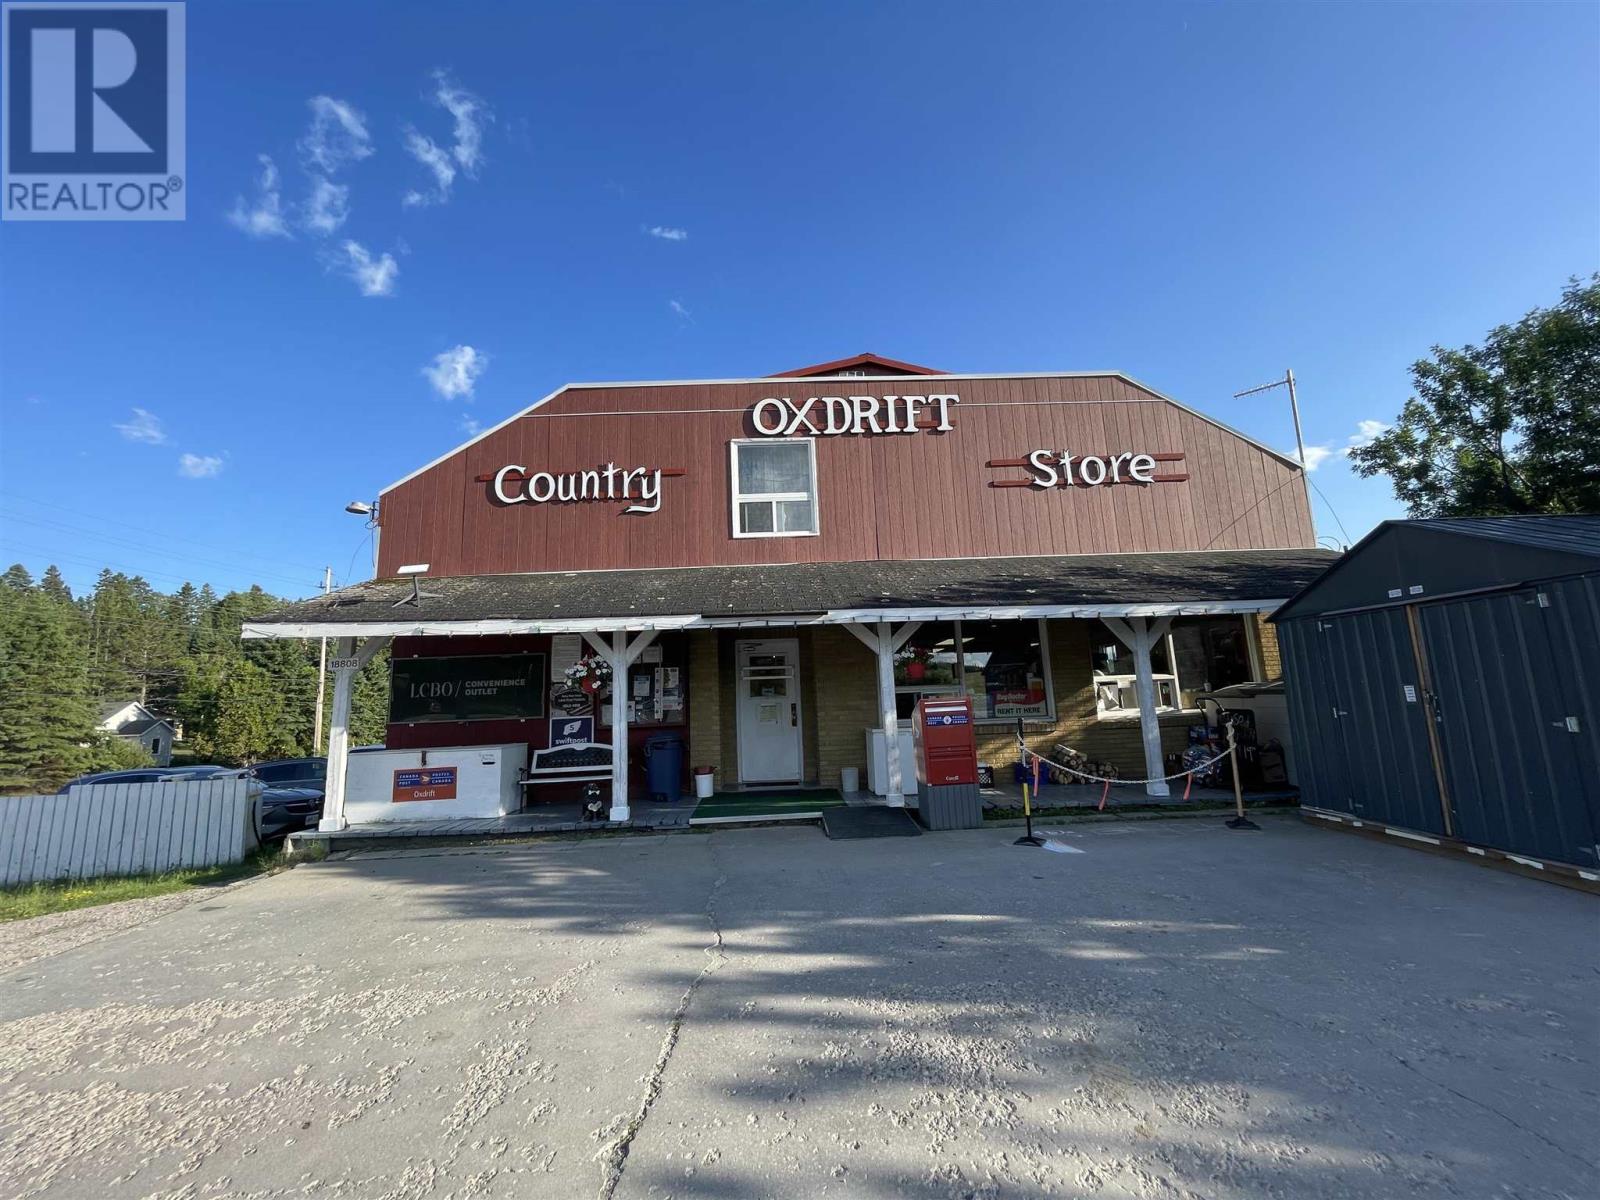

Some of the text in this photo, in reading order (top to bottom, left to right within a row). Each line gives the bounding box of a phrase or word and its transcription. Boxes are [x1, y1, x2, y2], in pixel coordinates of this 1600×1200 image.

[753, 394, 960, 435] OXDRIFT
[1030, 449, 1156, 487] Store
[494, 461, 662, 513] Country
[331, 660, 358, 668] 18808
[465, 679, 526, 688] CONVENIENCE
[465, 688, 498, 696] OUTLET
[413, 790, 436, 798] Oxdrift
